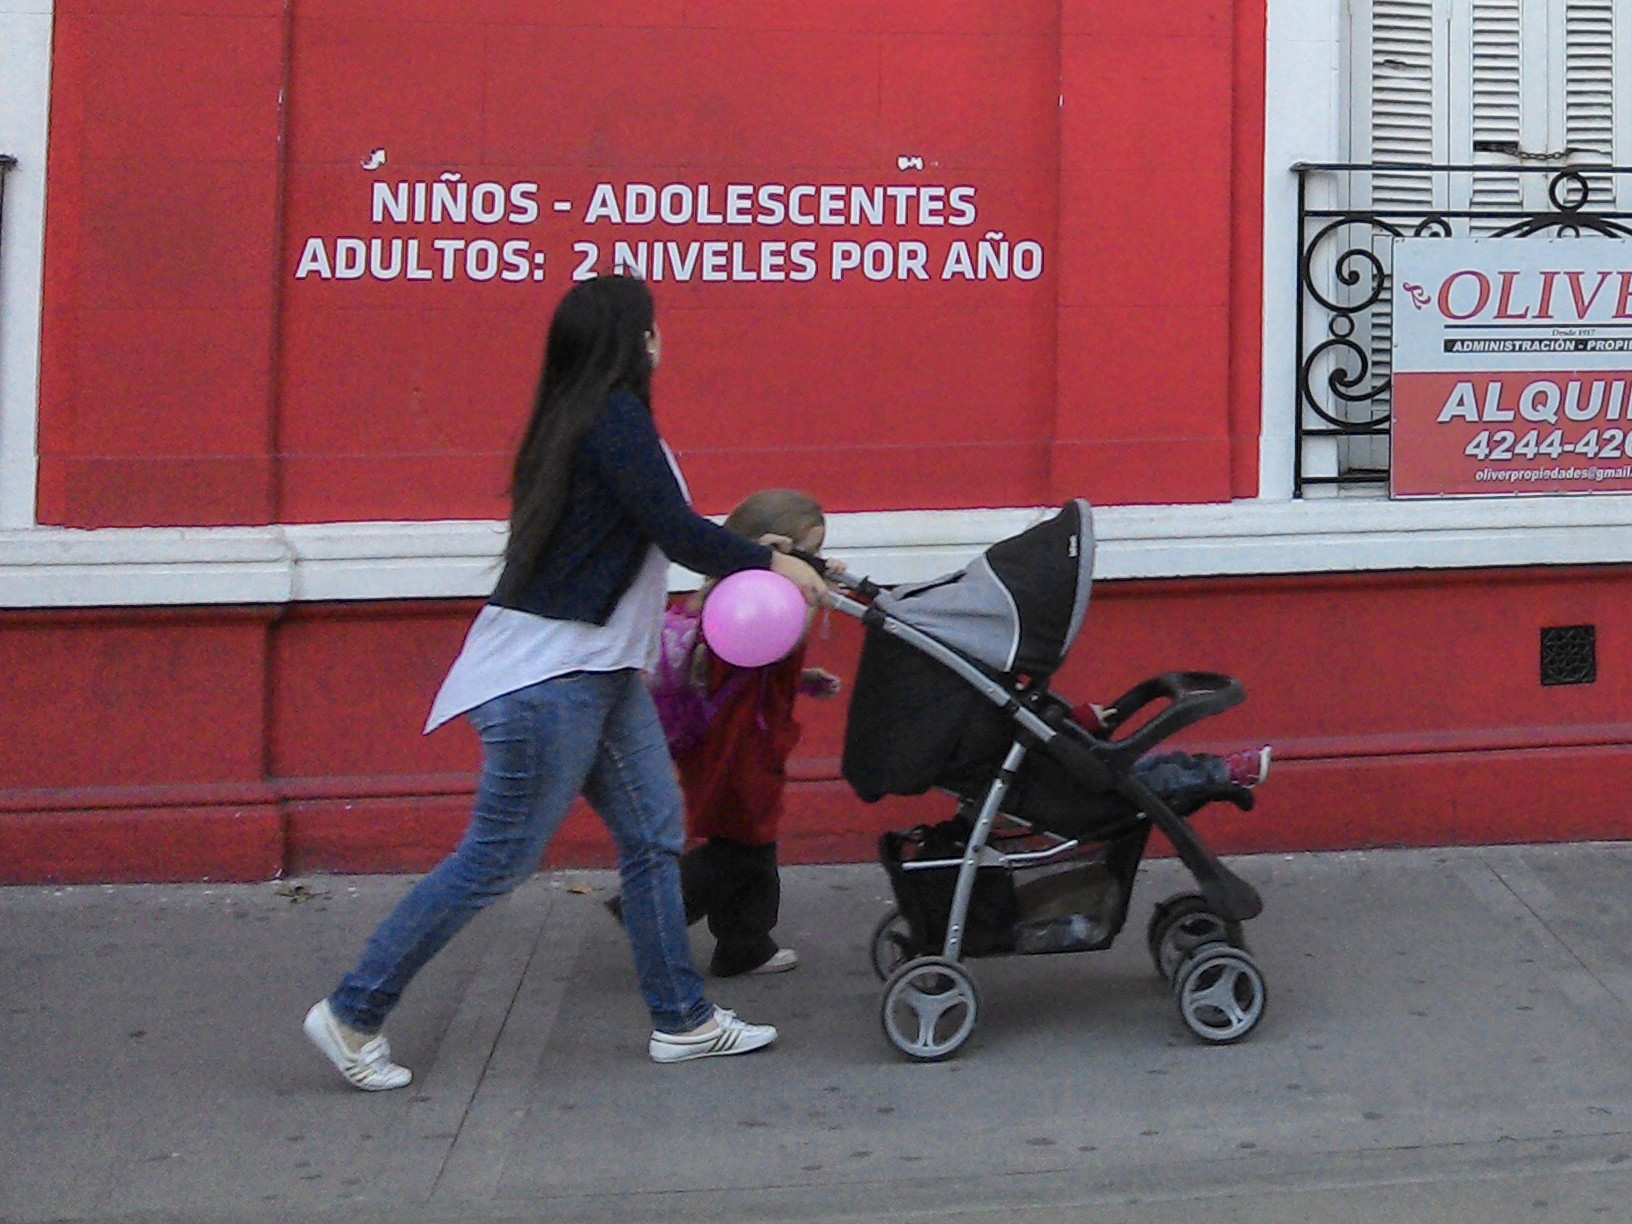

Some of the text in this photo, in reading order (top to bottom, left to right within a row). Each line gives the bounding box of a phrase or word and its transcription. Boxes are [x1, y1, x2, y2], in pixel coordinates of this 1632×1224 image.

[370, 171, 539, 224] NIÑOS
[584, 182, 977, 226] ADOLESCENTES
[294, 230, 1045, 283] ADULTOS: 2 NIVELES POR AÑO
[1452, 337, 1576, 353] ADMINISTRACIÓN
